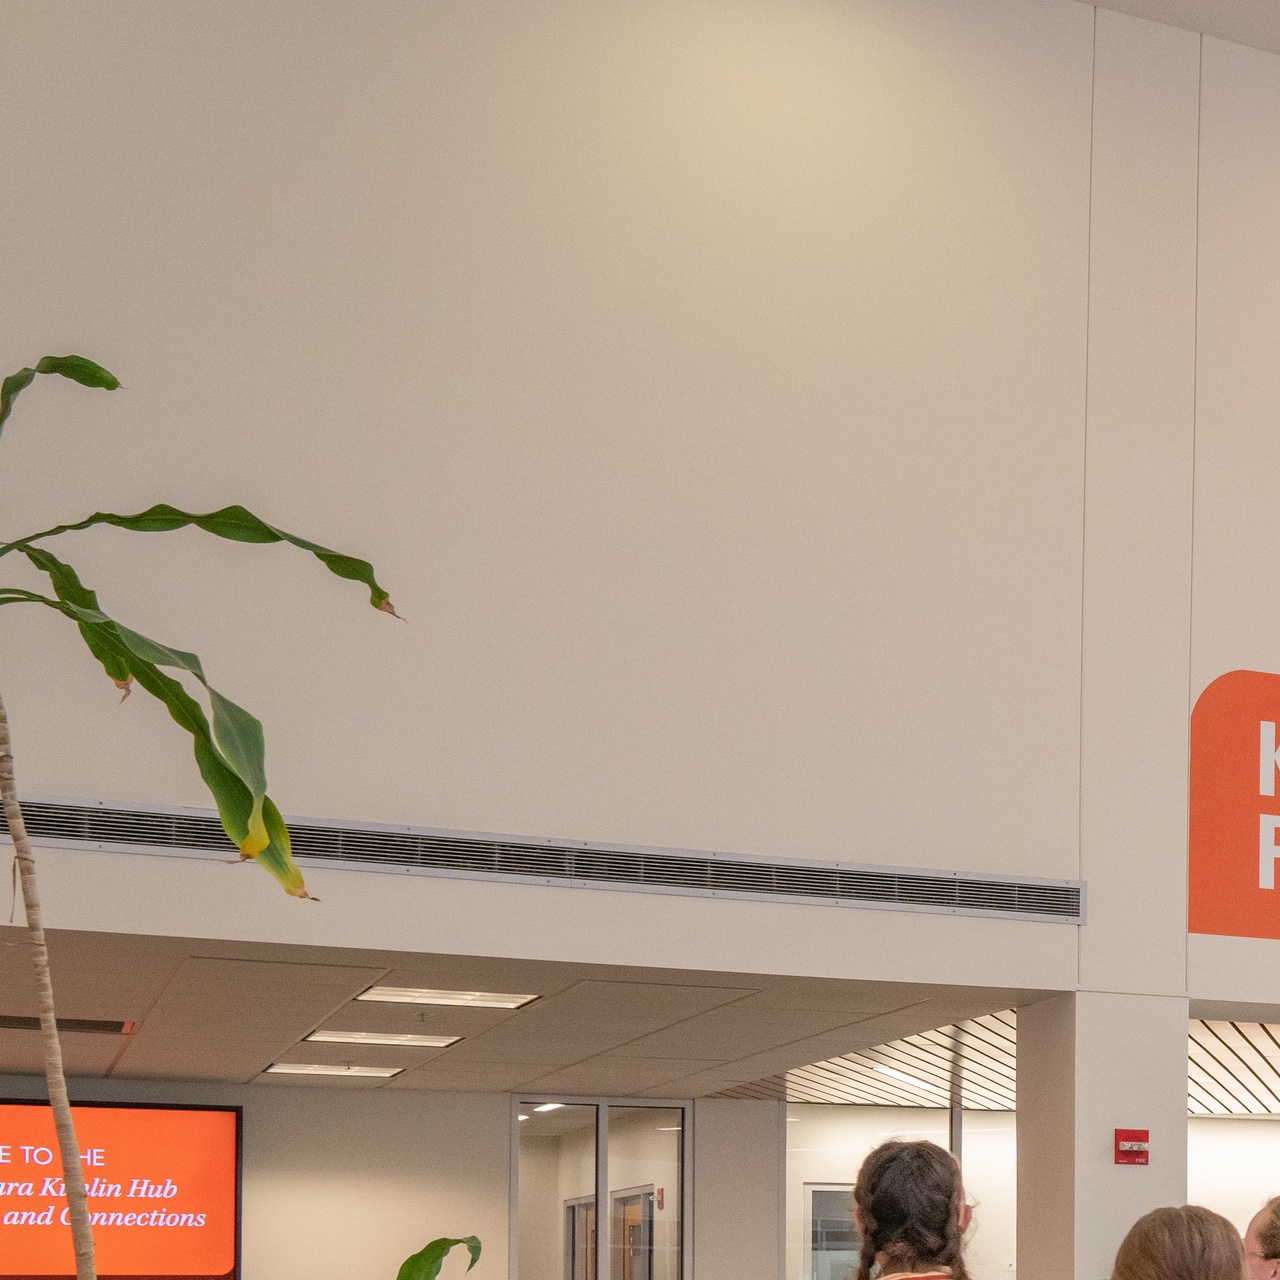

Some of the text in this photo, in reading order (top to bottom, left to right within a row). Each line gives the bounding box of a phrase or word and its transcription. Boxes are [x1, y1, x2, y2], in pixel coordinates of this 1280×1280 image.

[20, 1146, 53, 1166] TO
[79, 1148, 105, 1167] HE
[126, 1178, 178, 1198] Hub
[2, 1205, 55, 1226] and
